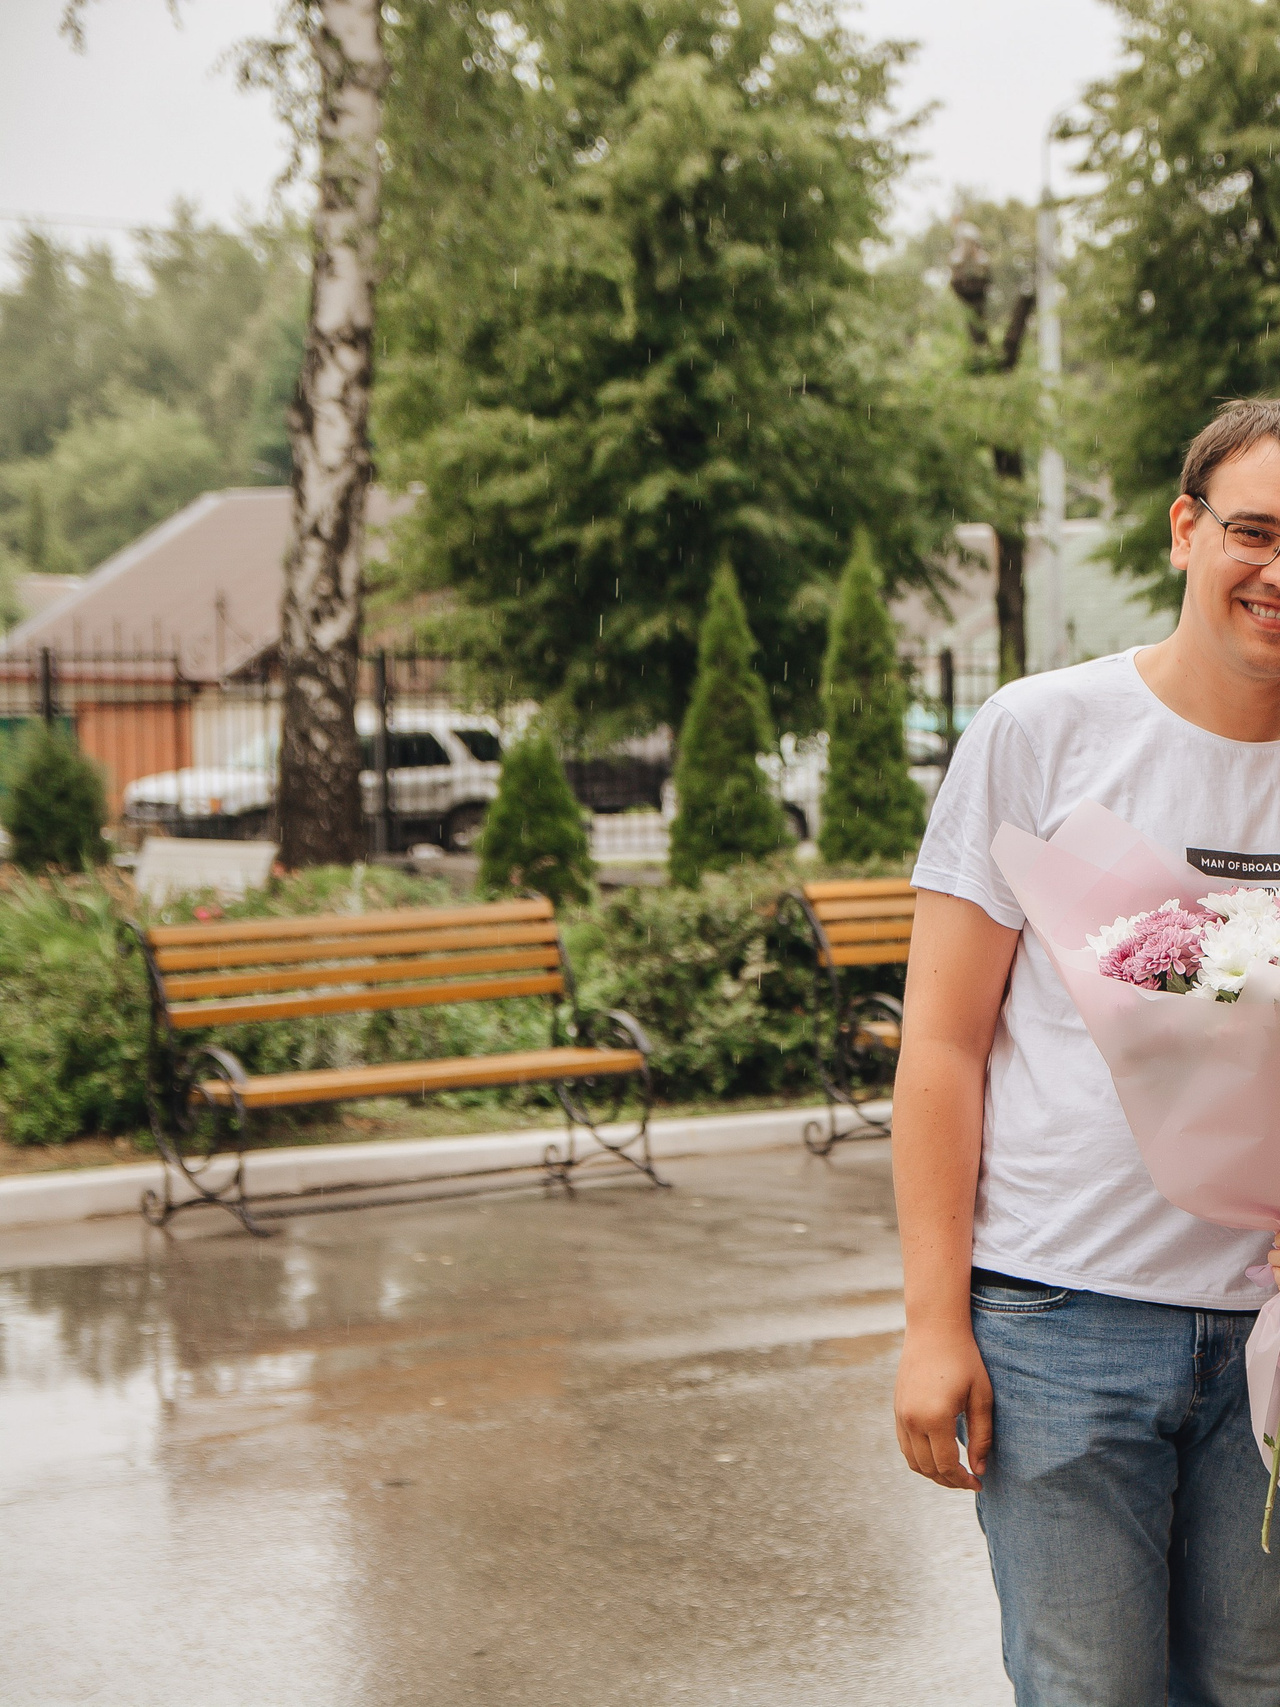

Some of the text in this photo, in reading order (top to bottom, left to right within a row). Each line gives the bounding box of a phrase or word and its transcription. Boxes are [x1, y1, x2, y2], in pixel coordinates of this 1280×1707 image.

[1201, 857, 1225, 869] MAN
[1227, 861, 1241, 871] OF
[1242, 862, 1280, 872] BROAD
